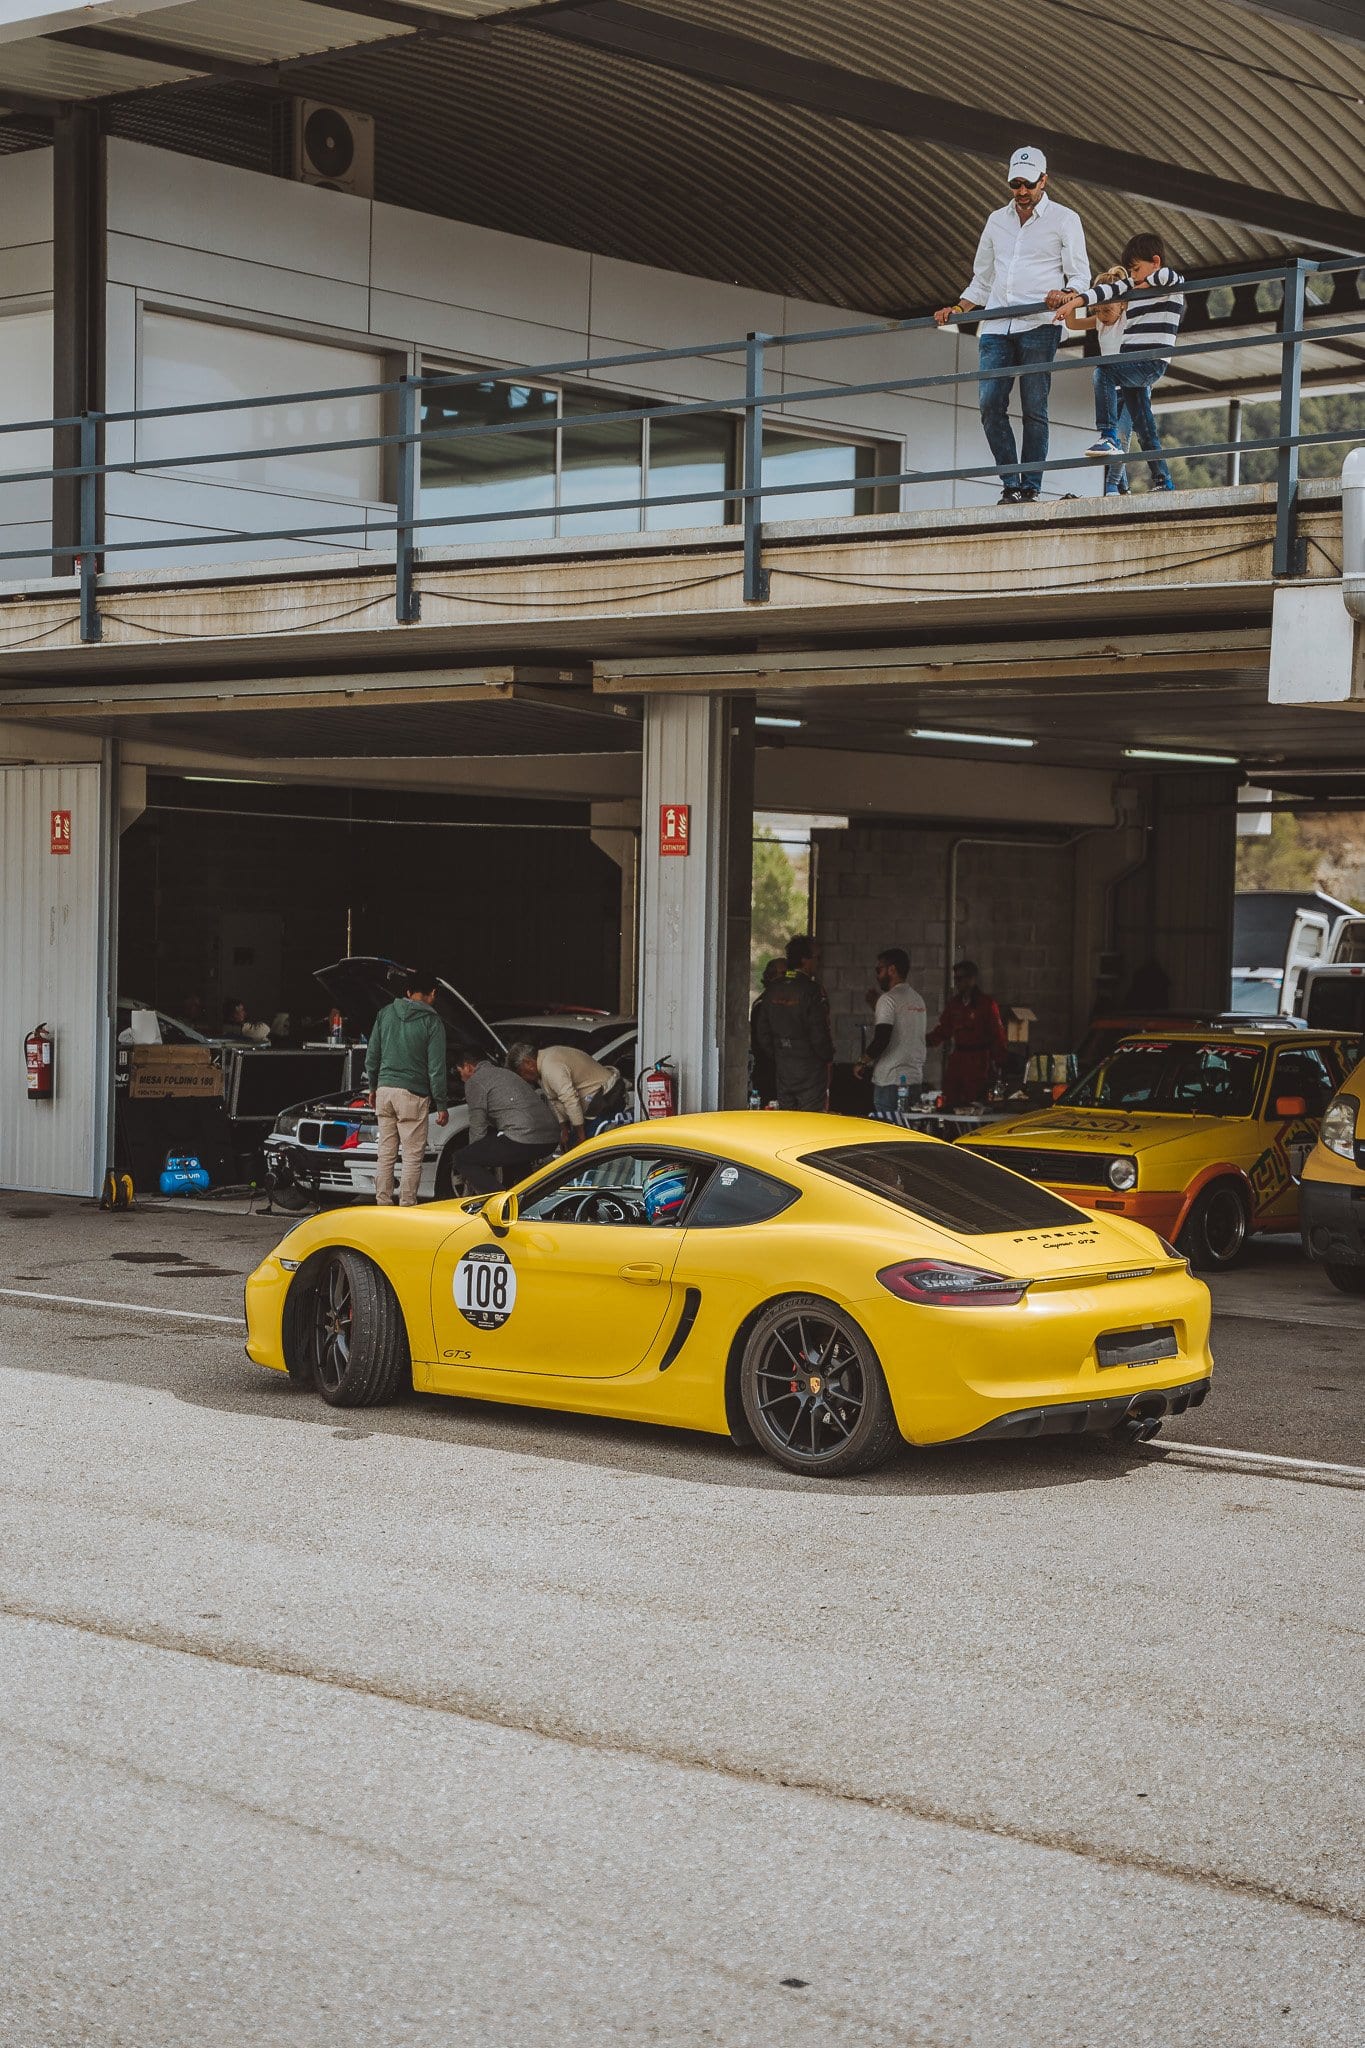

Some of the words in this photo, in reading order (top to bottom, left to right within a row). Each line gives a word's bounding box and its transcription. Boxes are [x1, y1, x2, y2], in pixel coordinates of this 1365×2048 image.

[139, 1075, 161, 1085] MESA
[164, 1075, 198, 1086] FOLDING
[1013, 1230, 1100, 1243] PORSCHE
[1042, 1241, 1074, 1249] Cayman
[463, 1263, 508, 1309] 108
[443, 1349, 472, 1360] GTS
